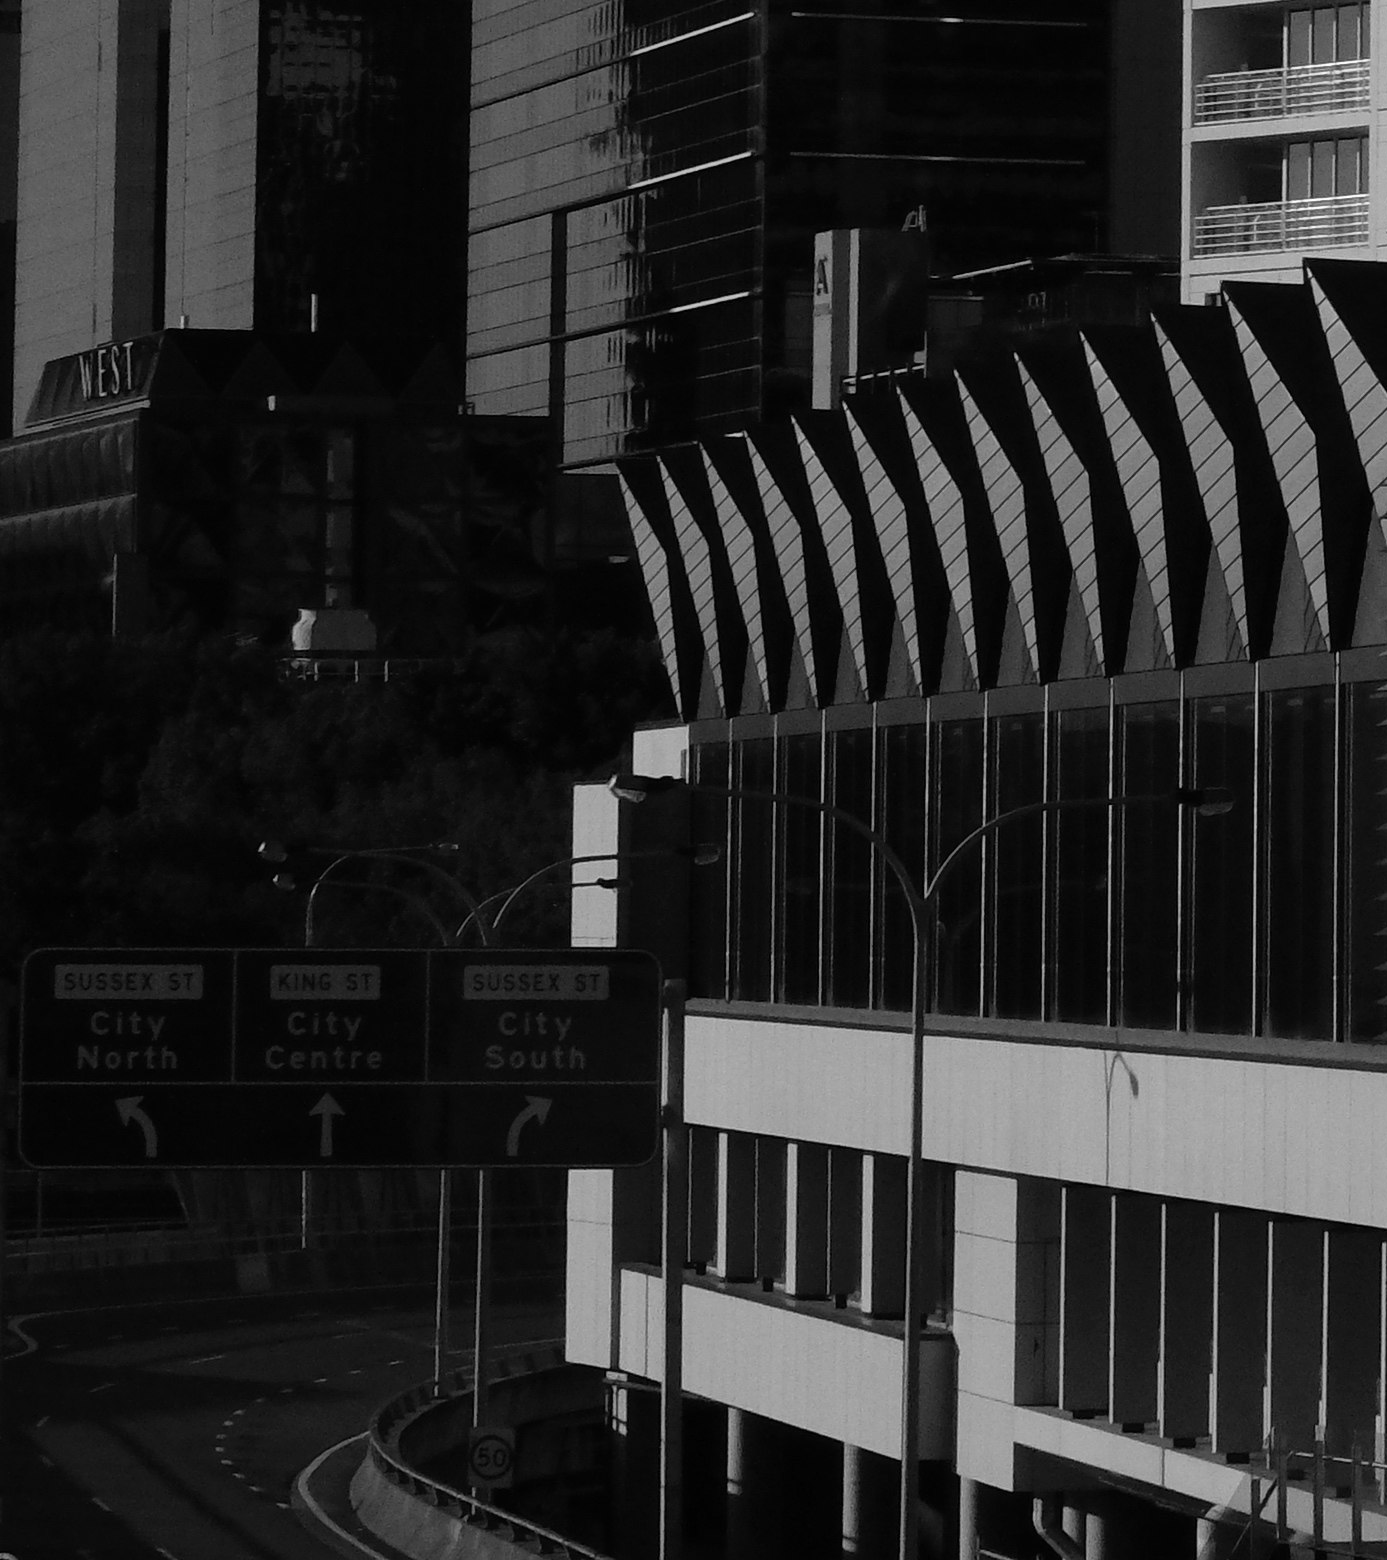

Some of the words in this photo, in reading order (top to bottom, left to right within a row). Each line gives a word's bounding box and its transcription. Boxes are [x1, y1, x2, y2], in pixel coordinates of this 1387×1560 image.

[78, 341, 134, 401] WEST
[63, 972, 154, 992] SUSSEX
[167, 971, 195, 991] ST
[277, 971, 332, 992] KING
[346, 972, 373, 992] ST
[471, 973, 561, 993] SUSSEX
[574, 972, 601, 992] ST
[90, 1010, 166, 1041] City
[287, 1010, 362, 1041] City
[497, 1011, 572, 1041] City
[77, 1044, 179, 1070] North
[265, 1044, 383, 1070] Centre
[484, 1045, 587, 1070] South
[477, 1446, 507, 1468] 50
